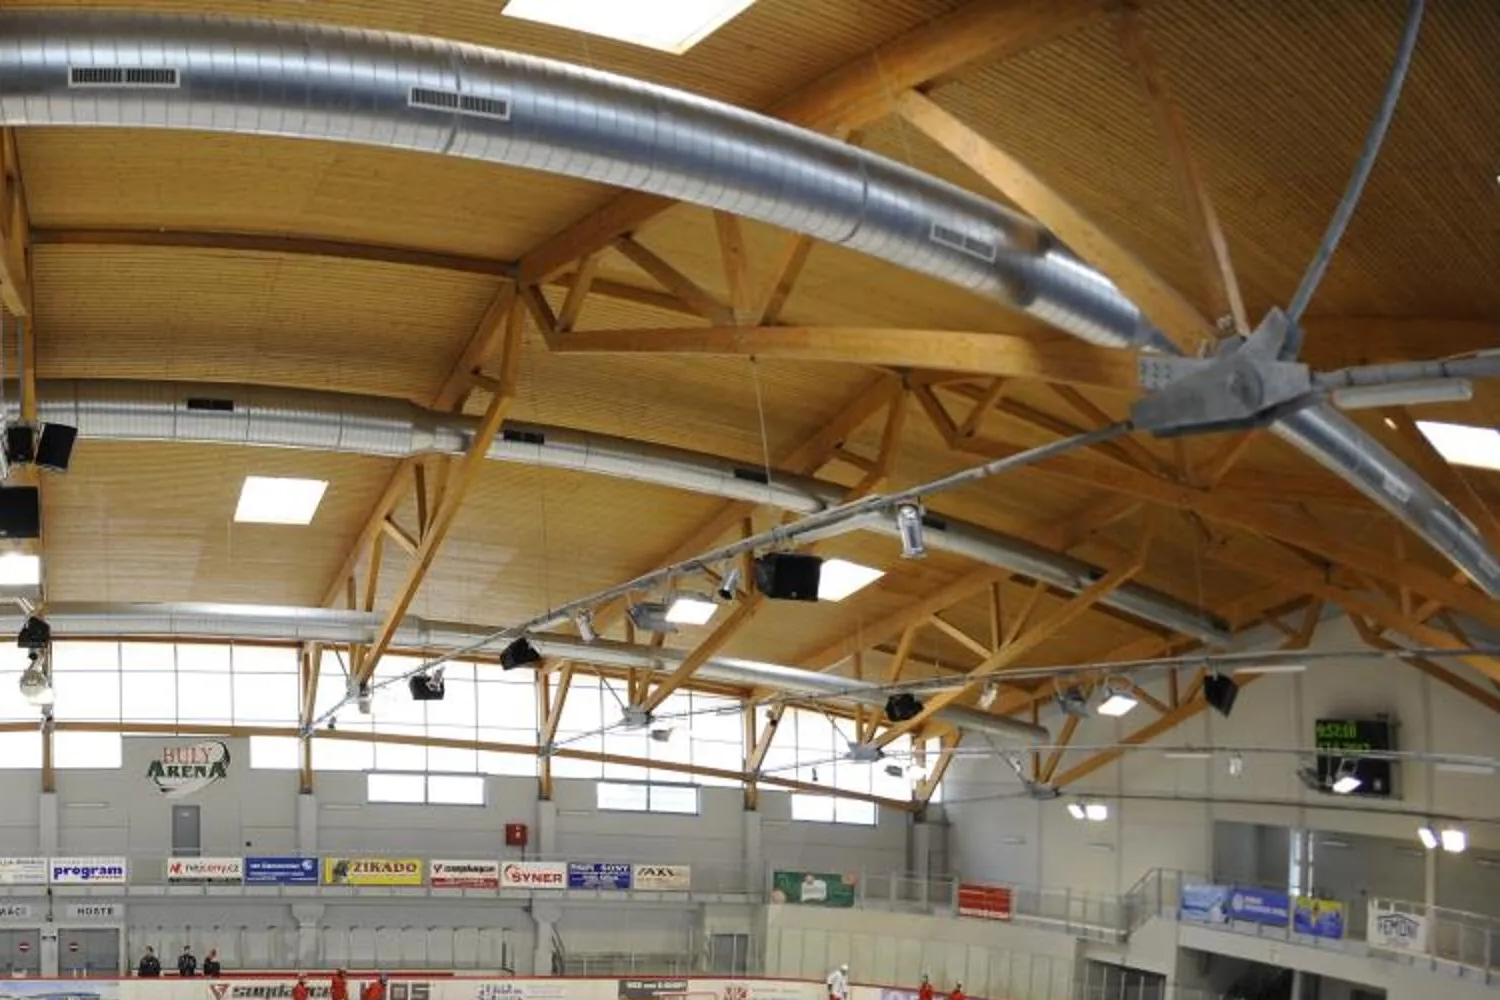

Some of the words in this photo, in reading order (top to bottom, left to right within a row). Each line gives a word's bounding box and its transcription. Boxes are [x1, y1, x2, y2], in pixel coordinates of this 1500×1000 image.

[163, 746, 213, 764] BULY
[147, 759, 227, 778] ARENA
[53, 865, 123, 880] program
[353, 862, 418, 874] ZIKADO
[511, 871, 563, 884] SYNER
